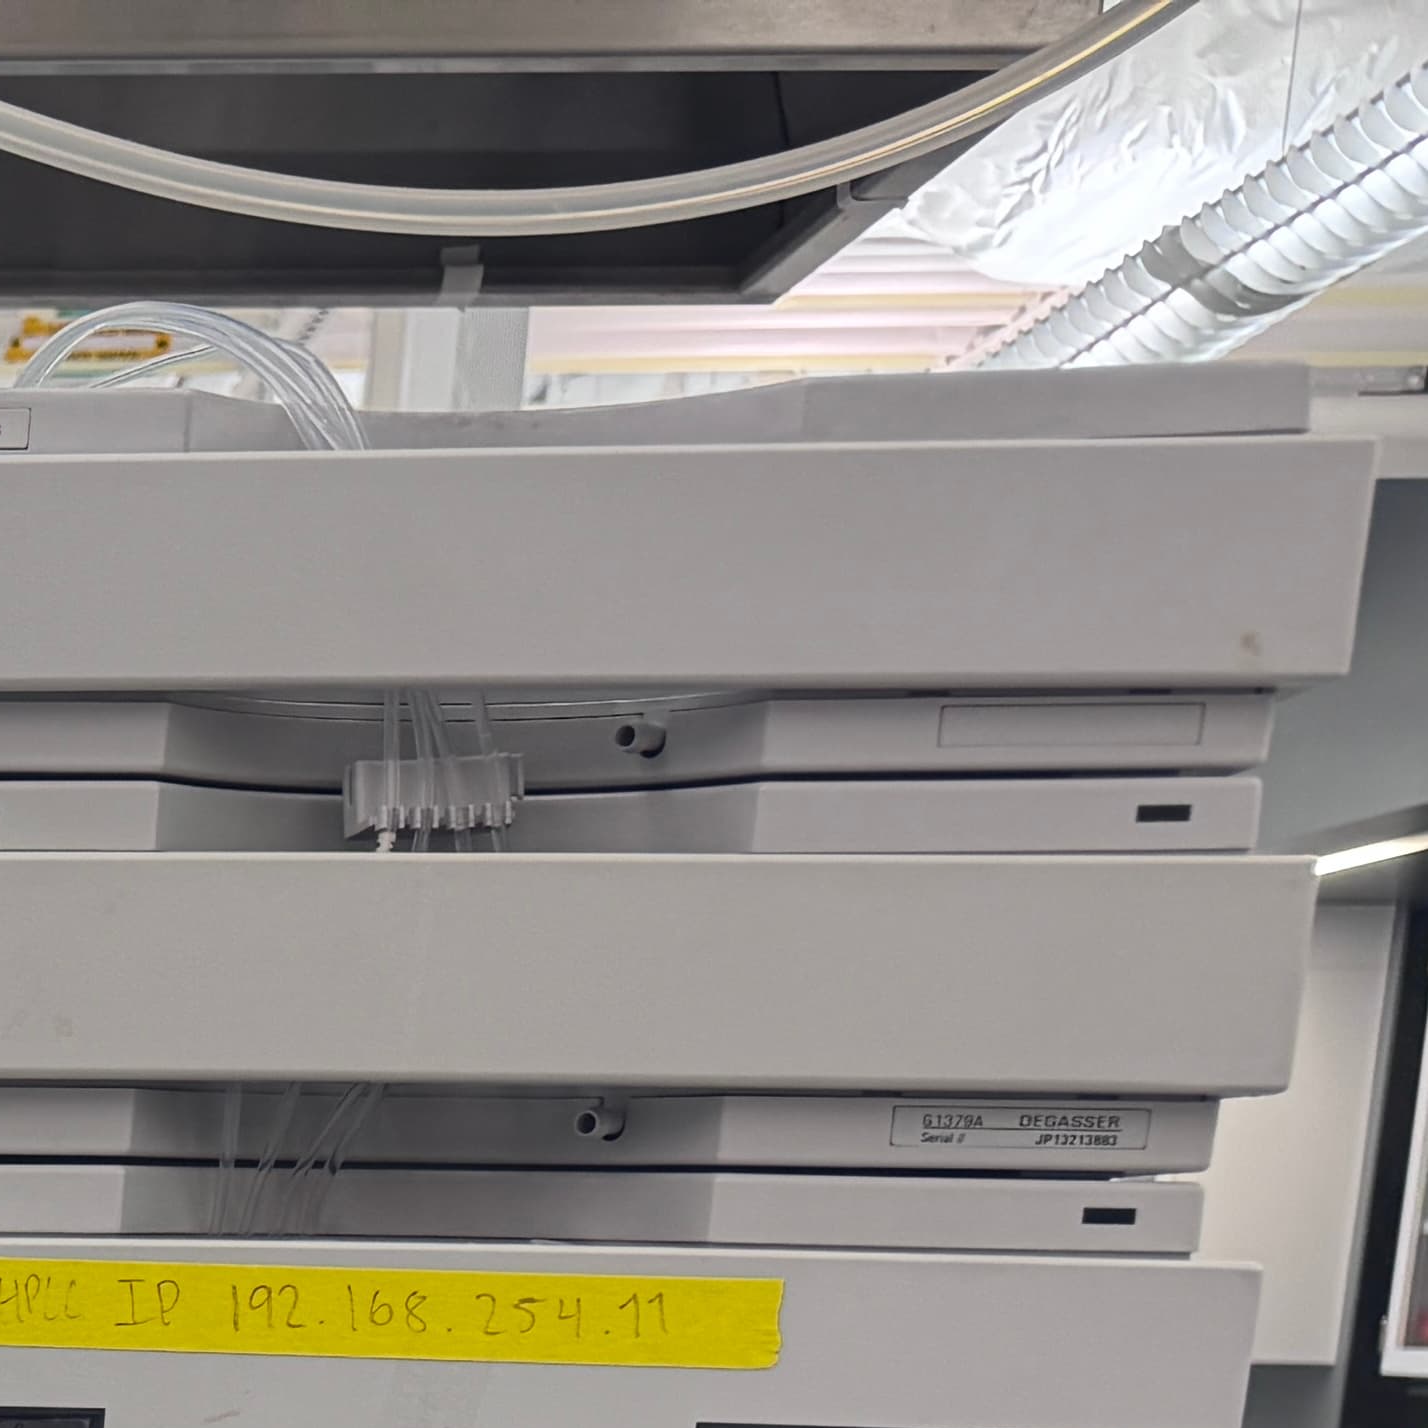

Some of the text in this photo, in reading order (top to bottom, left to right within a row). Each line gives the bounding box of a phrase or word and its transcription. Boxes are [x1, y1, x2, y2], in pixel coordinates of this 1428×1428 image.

[1019, 1115, 1122, 1129] DEGASSER
[920, 1131, 955, 1145] Serial
[114, 1279, 181, 1326] IP
